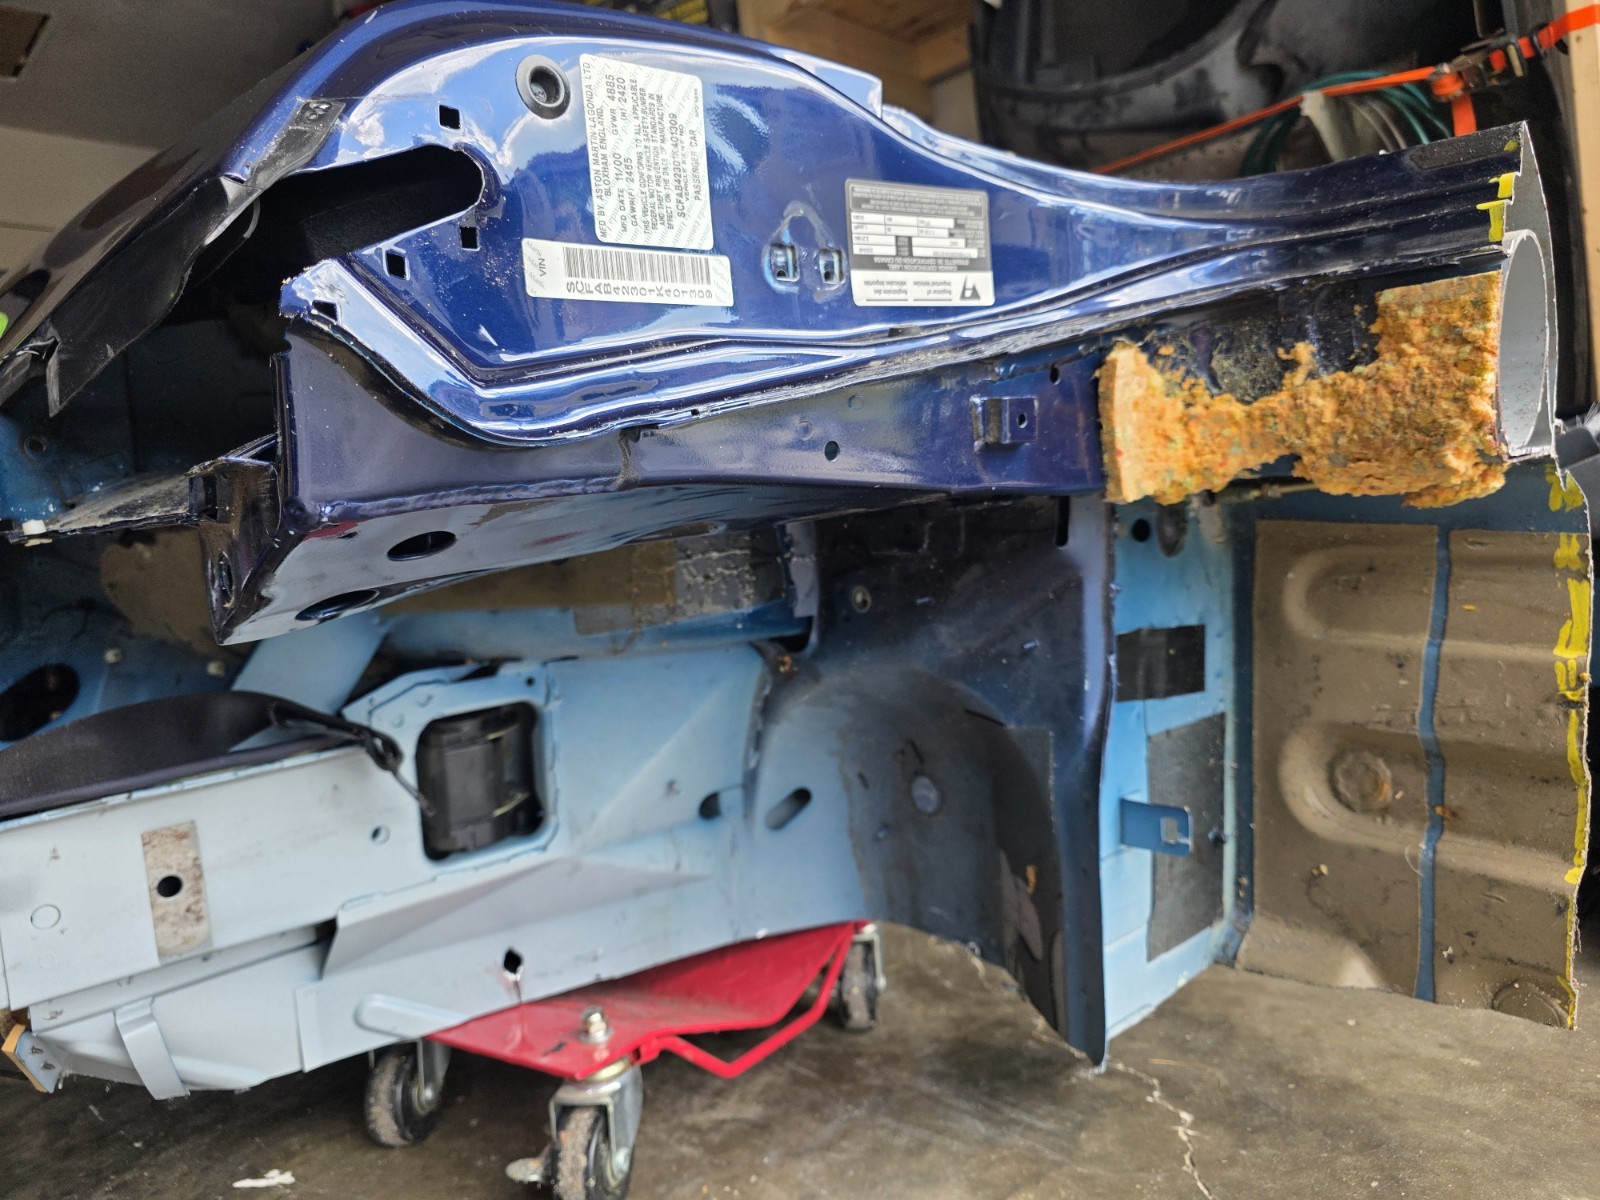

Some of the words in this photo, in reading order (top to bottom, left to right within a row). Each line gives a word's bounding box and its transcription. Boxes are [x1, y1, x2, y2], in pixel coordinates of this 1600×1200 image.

[583, 63, 591, 79] LTD
[606, 74, 615, 101] 4885
[617, 77, 627, 103] 2420
[630, 79, 639, 120] APPLICABLE
[586, 84, 596, 128] LAGONDA
[610, 108, 618, 135] GVWR
[649, 103, 658, 143] STANDARDS
[589, 132, 599, 165] MARTIN
[636, 139, 642, 147] TO
[660, 146, 666, 154] OF
[689, 130, 697, 147] CAR
[613, 153, 623, 181] 11/00
[624, 158, 634, 183] 2465
[637, 152, 646, 188] CONFORMS
[644, 145, 652, 171] VEHICLE
[653, 146, 662, 187] PREVENTION
[594, 169, 603, 200] ASTON
[601, 154, 611, 196] BLOXHAM
[647, 175, 655, 198] MOTOR
[691, 151, 701, 201] PASSENGER
[597, 205, 605, 216] BY
[618, 188, 626, 211] DATE
[628, 189, 638, 226] GAWR(F)
[656, 190, 664, 209] THEFT
[665, 194, 671, 203] ON
[650, 202, 658, 230] FEDERAL
[666, 206, 674, 229] EFFECT
[599, 221, 607, 238] MFD
[538, 258, 547, 277] VIN
